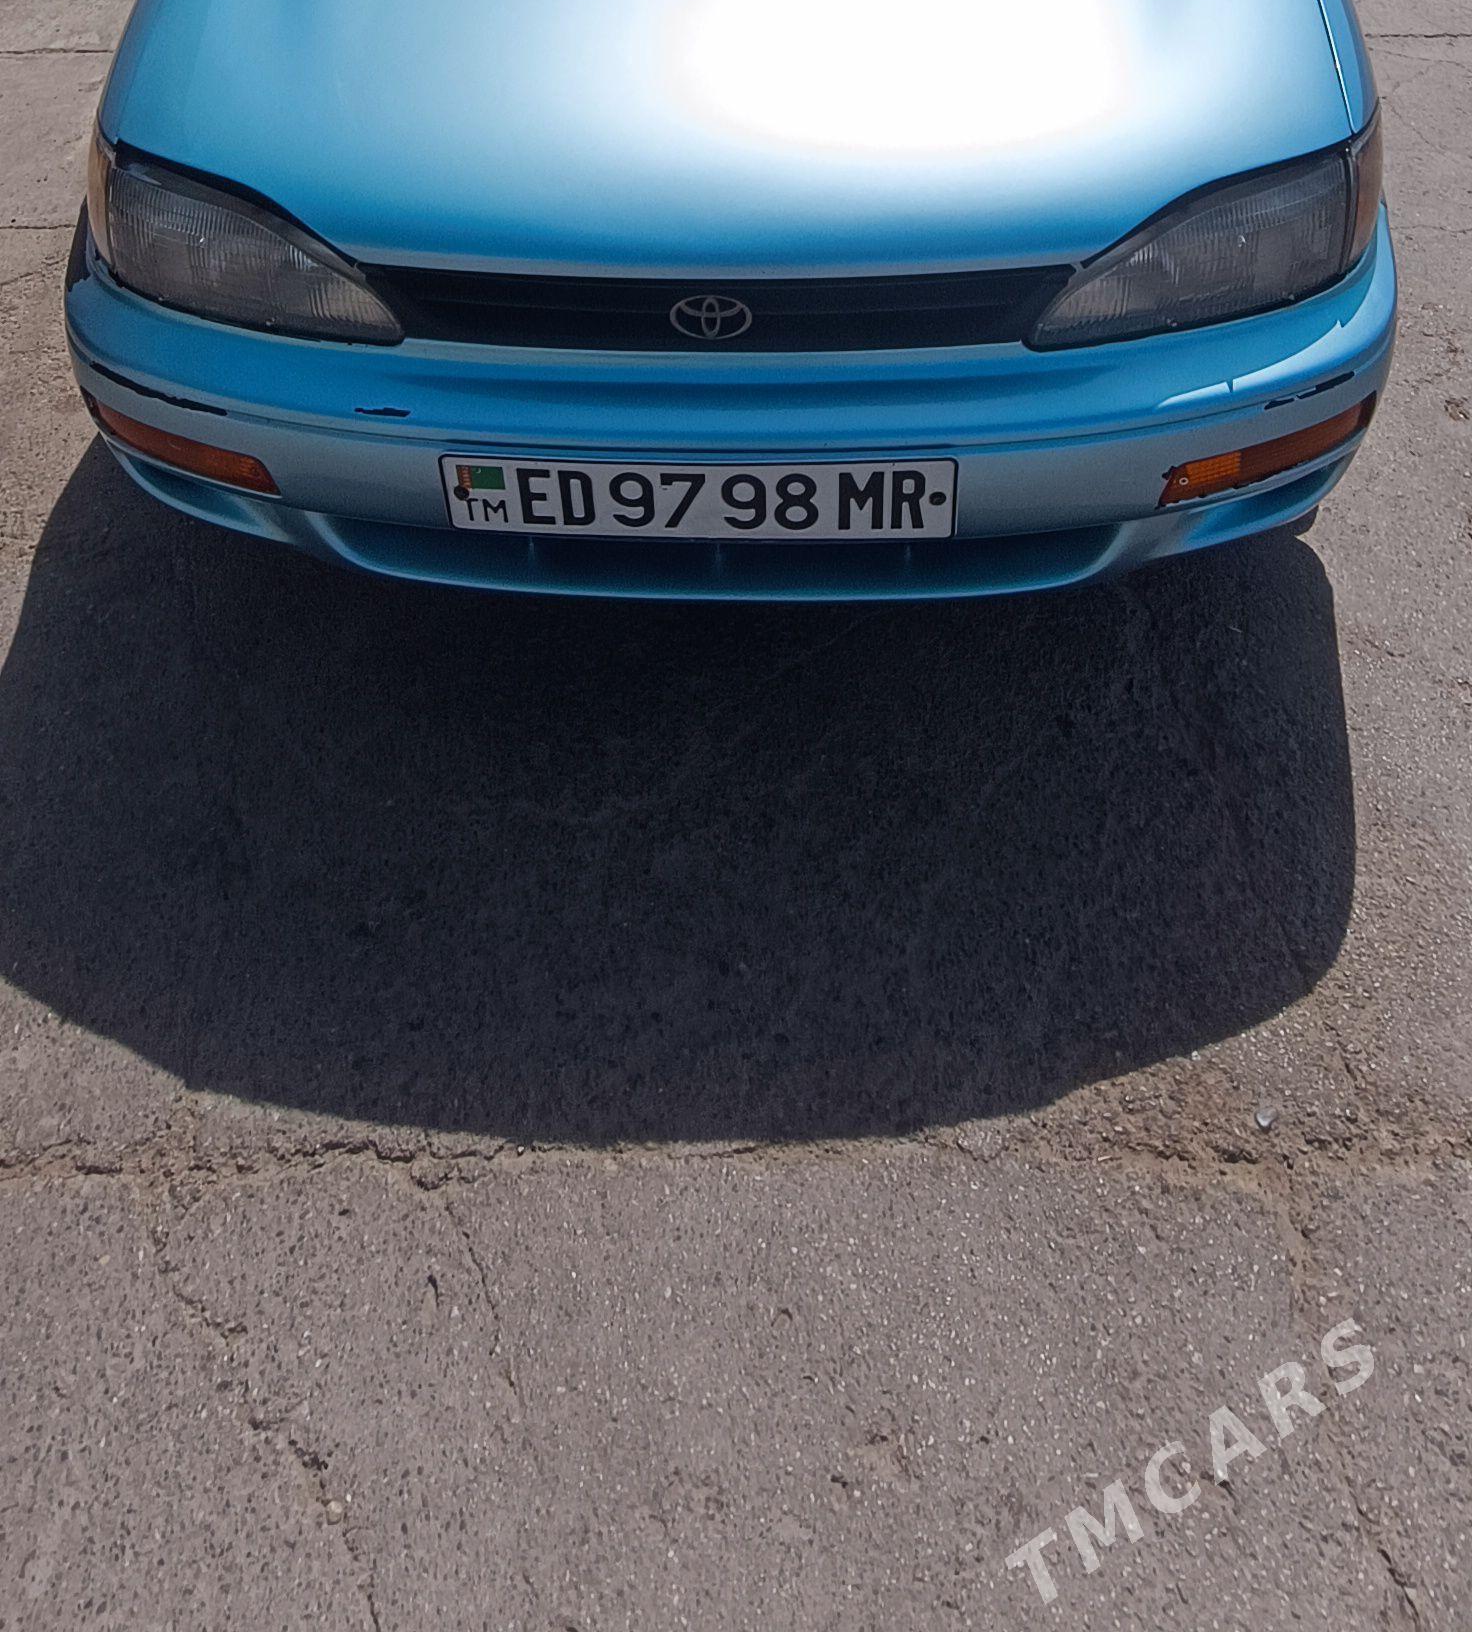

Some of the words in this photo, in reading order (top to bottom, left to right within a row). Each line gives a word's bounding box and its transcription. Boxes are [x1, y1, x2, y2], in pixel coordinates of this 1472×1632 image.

[465, 498, 509, 523] TM
[516, 468, 596, 526] ED
[609, 472, 706, 529] 97
[720, 473, 819, 531] 98
[837, 470, 926, 530] MR
